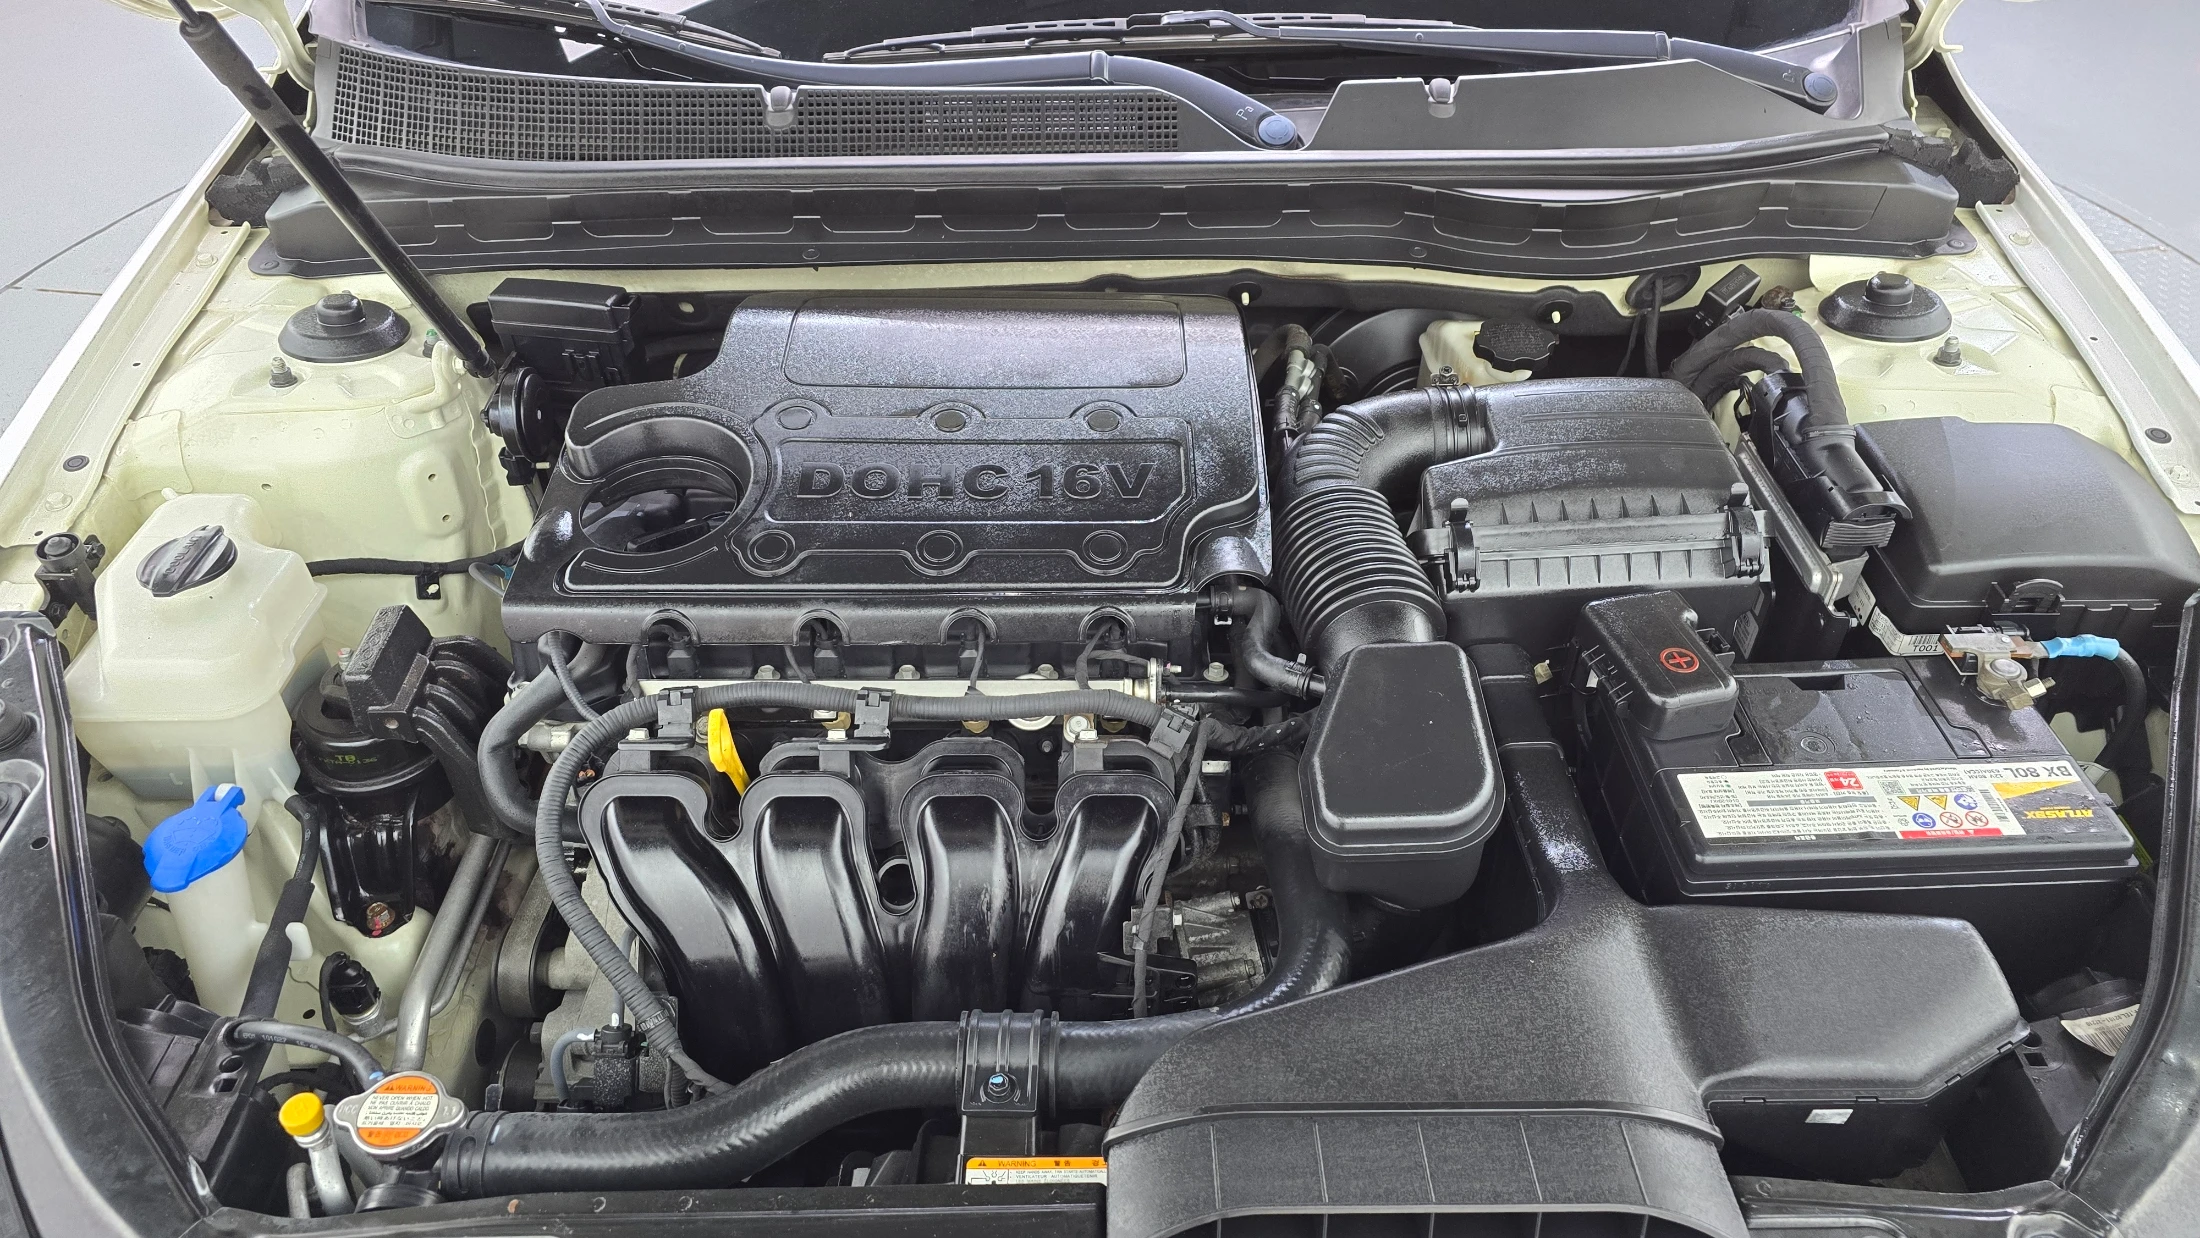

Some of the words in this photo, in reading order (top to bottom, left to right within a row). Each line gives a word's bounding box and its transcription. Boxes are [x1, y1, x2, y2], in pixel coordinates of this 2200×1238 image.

[796, 461, 1007, 500] DOHC
[1025, 460, 1155, 500] 16V
[1913, 644, 1939, 652] T001
[2002, 767, 2040, 778] 80L
[2042, 765, 2072, 778] BX
[2024, 808, 2093, 820] ATLASBX
